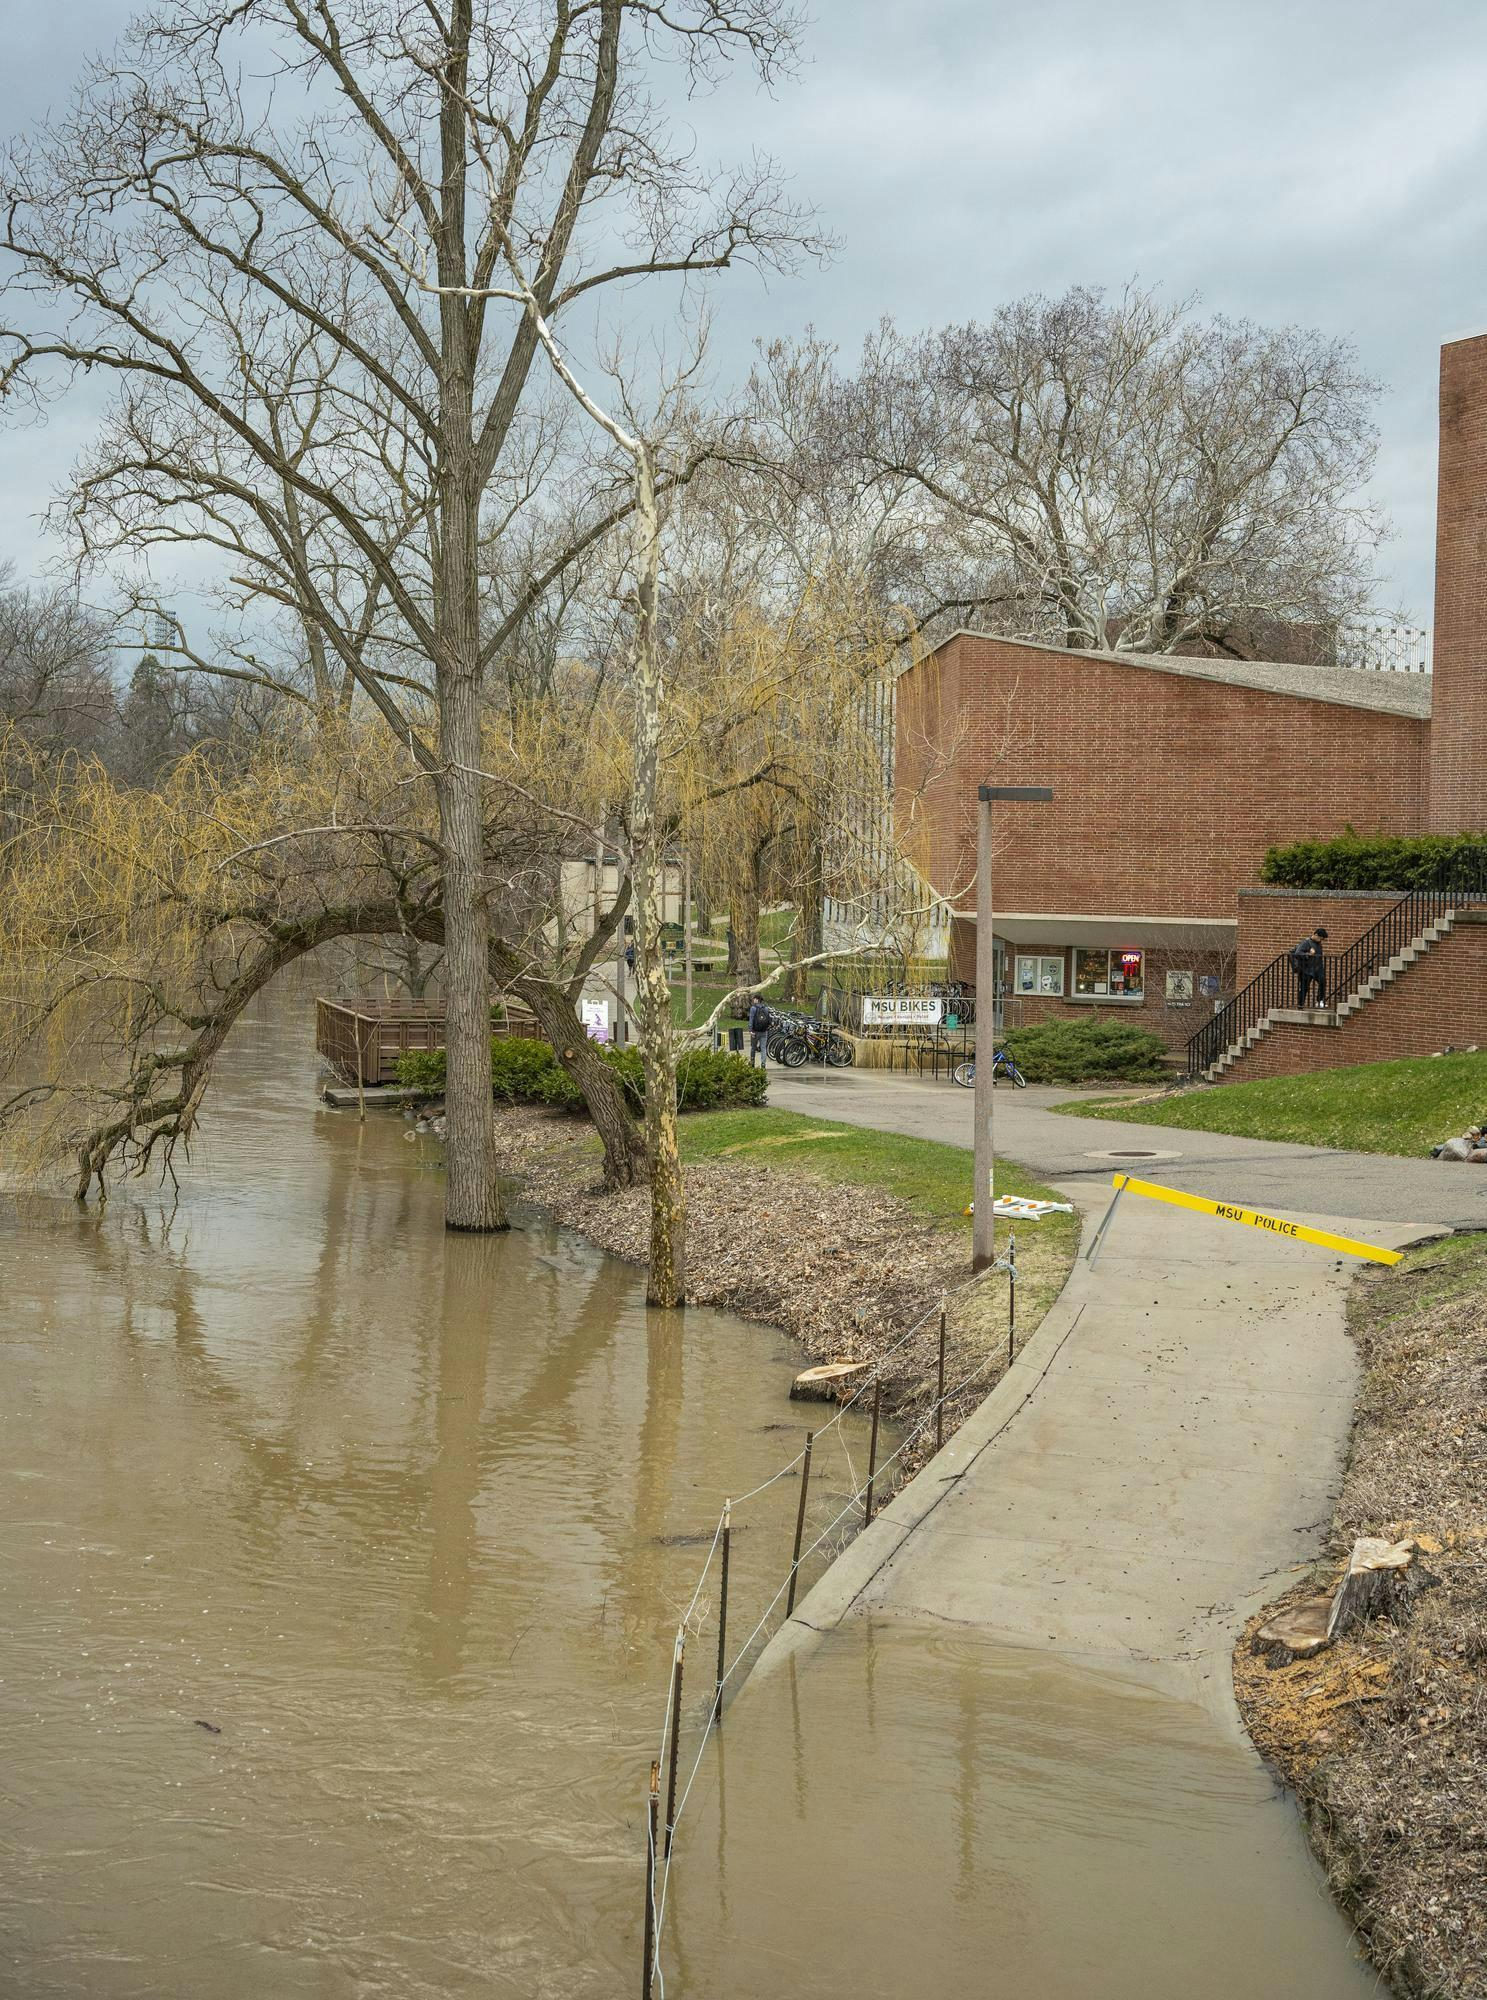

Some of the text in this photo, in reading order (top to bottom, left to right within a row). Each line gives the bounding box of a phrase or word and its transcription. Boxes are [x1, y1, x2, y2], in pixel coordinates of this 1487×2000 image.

[1122, 954, 1140, 962] OPEN
[871, 1001, 936, 1012] MSU BIKES
[1215, 1205, 1299, 1236] MSU POLICE
